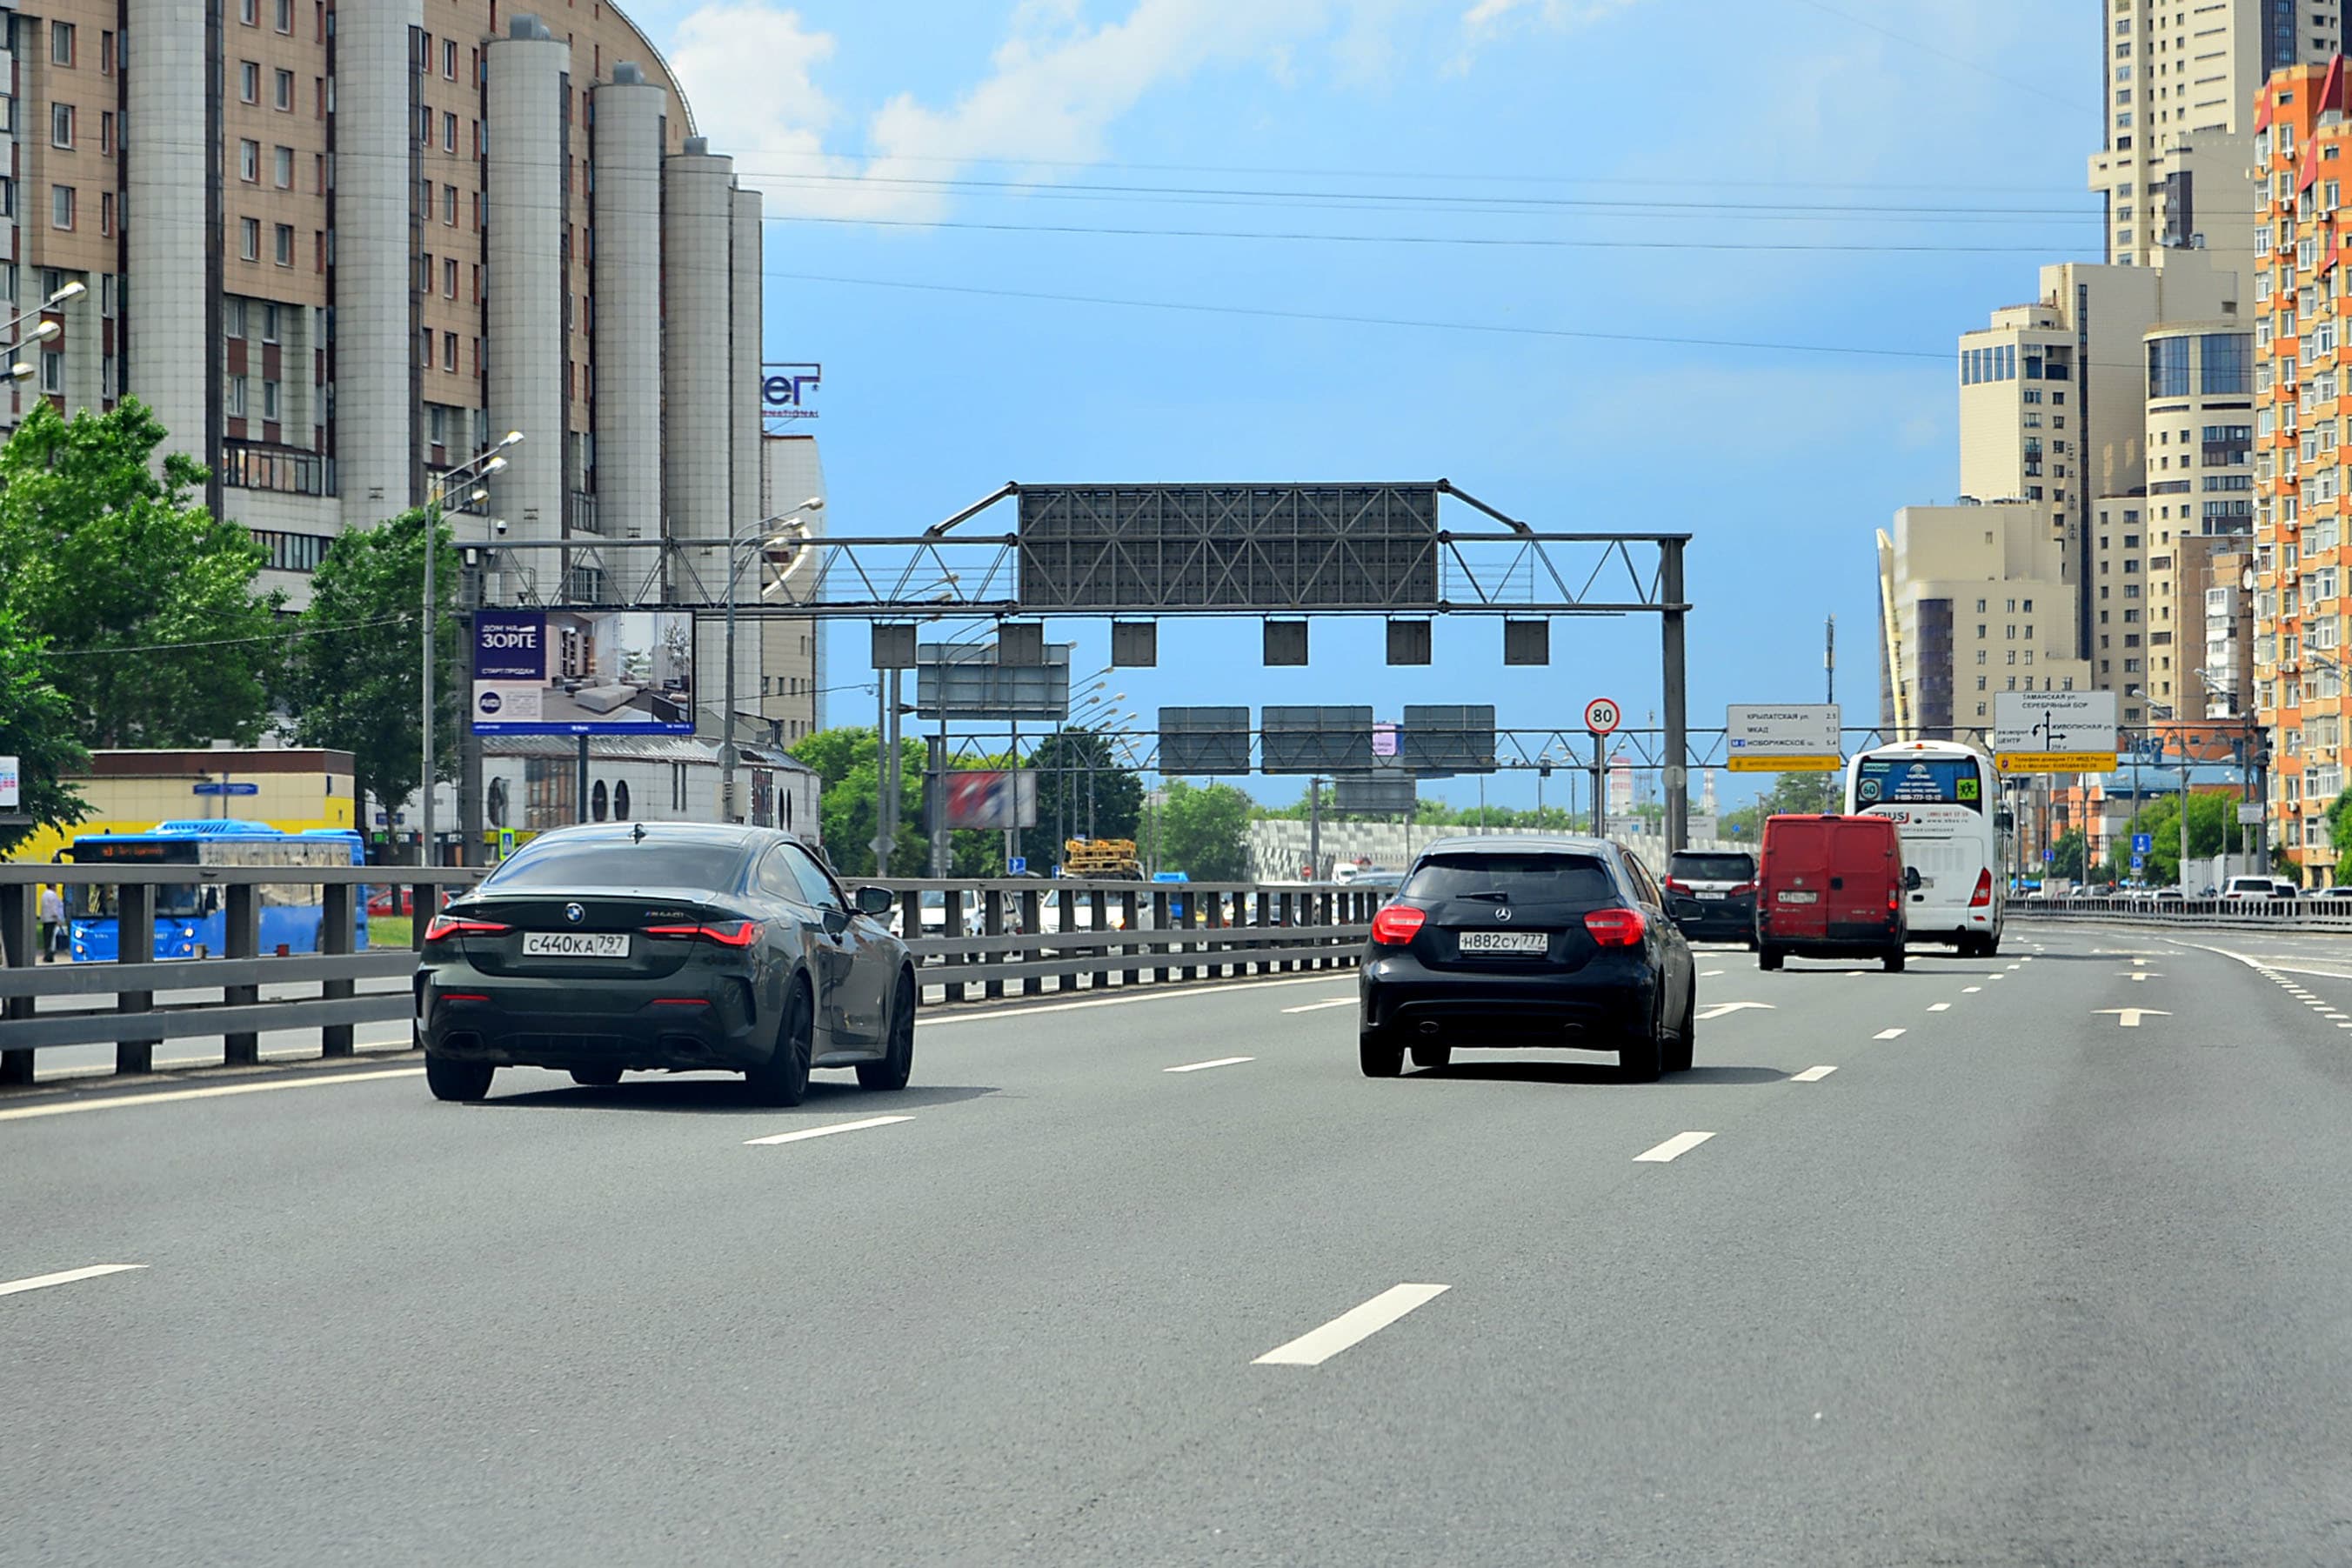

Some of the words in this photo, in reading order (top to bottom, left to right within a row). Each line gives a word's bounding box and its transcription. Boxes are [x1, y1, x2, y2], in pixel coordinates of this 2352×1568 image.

[482, 633, 537, 649] ЗОРГЕ
[1593, 709, 1613, 723] 80
[598, 936, 624, 949] 797
[1464, 934, 1519, 948] Н882СУ
[1522, 934, 1543, 945] 777
